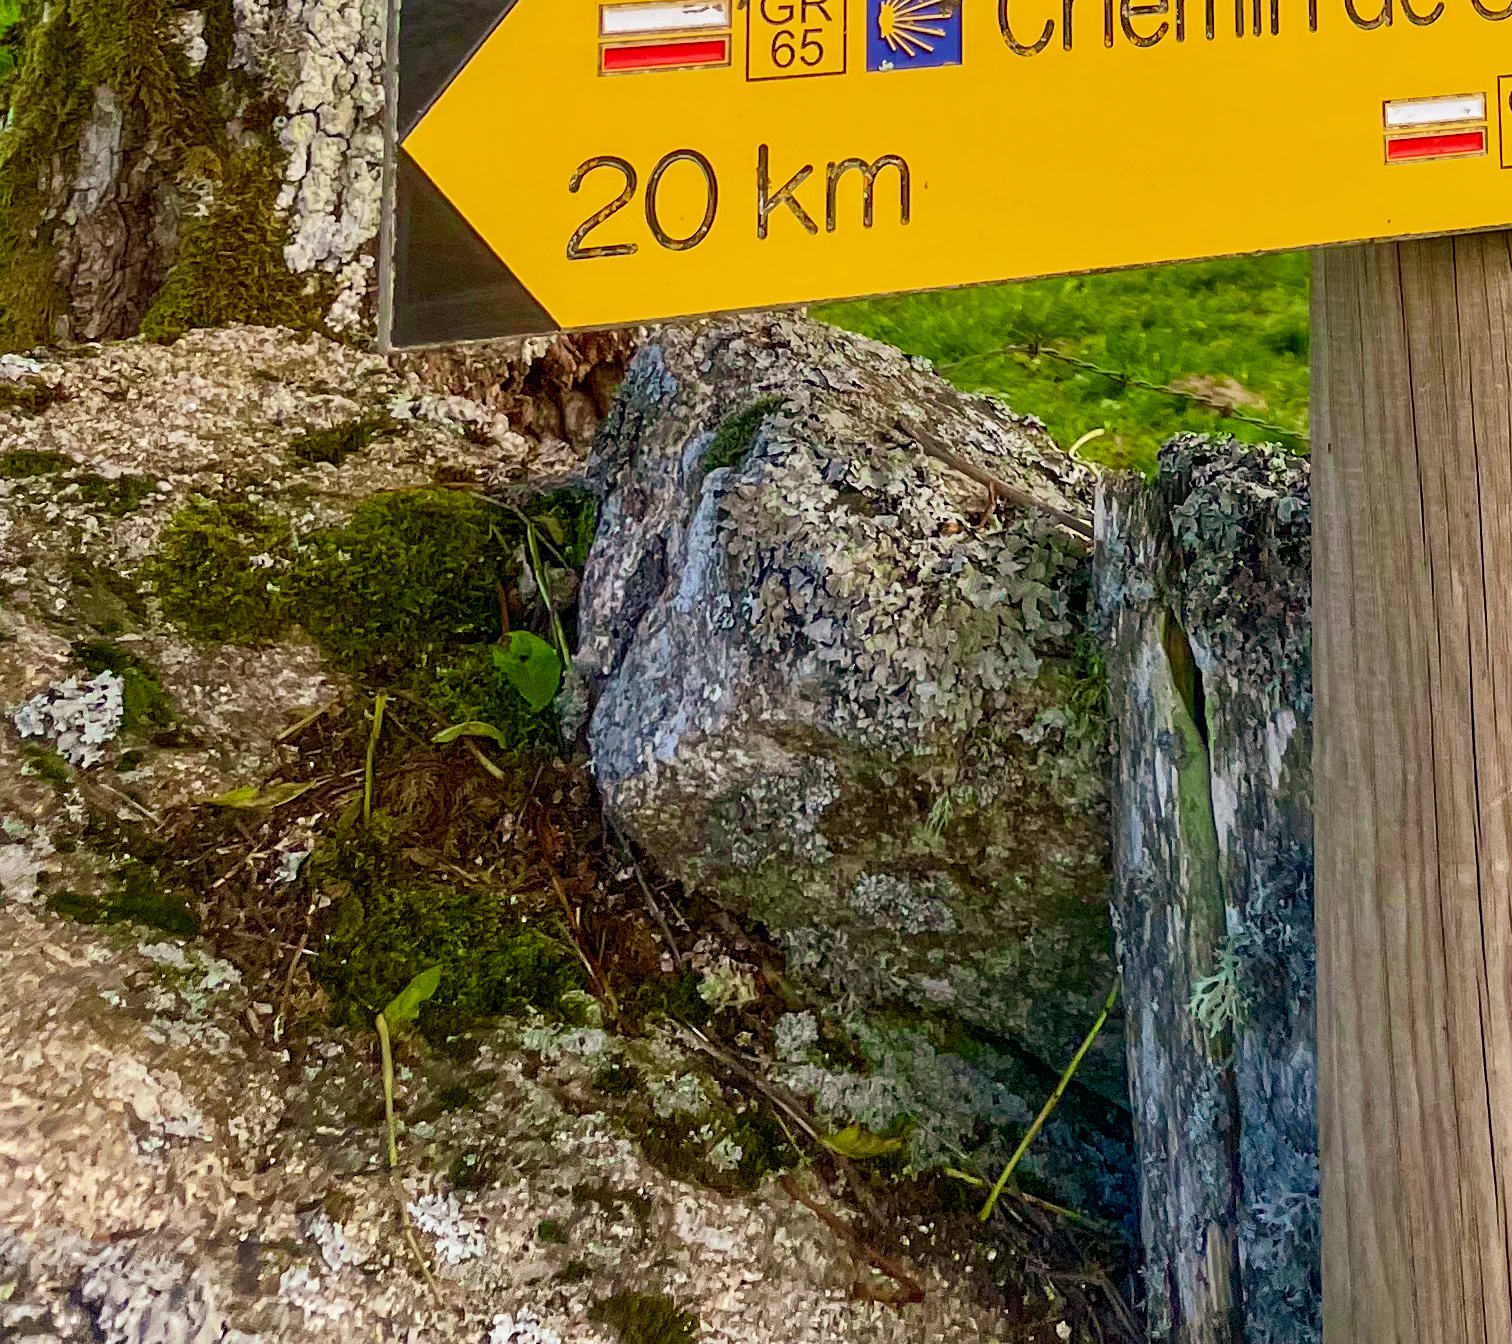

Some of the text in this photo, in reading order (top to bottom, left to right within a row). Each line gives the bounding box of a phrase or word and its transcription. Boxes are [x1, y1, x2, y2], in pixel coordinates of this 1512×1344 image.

[770, 28, 824, 69] 65
[567, 144, 910, 260] 20 km
